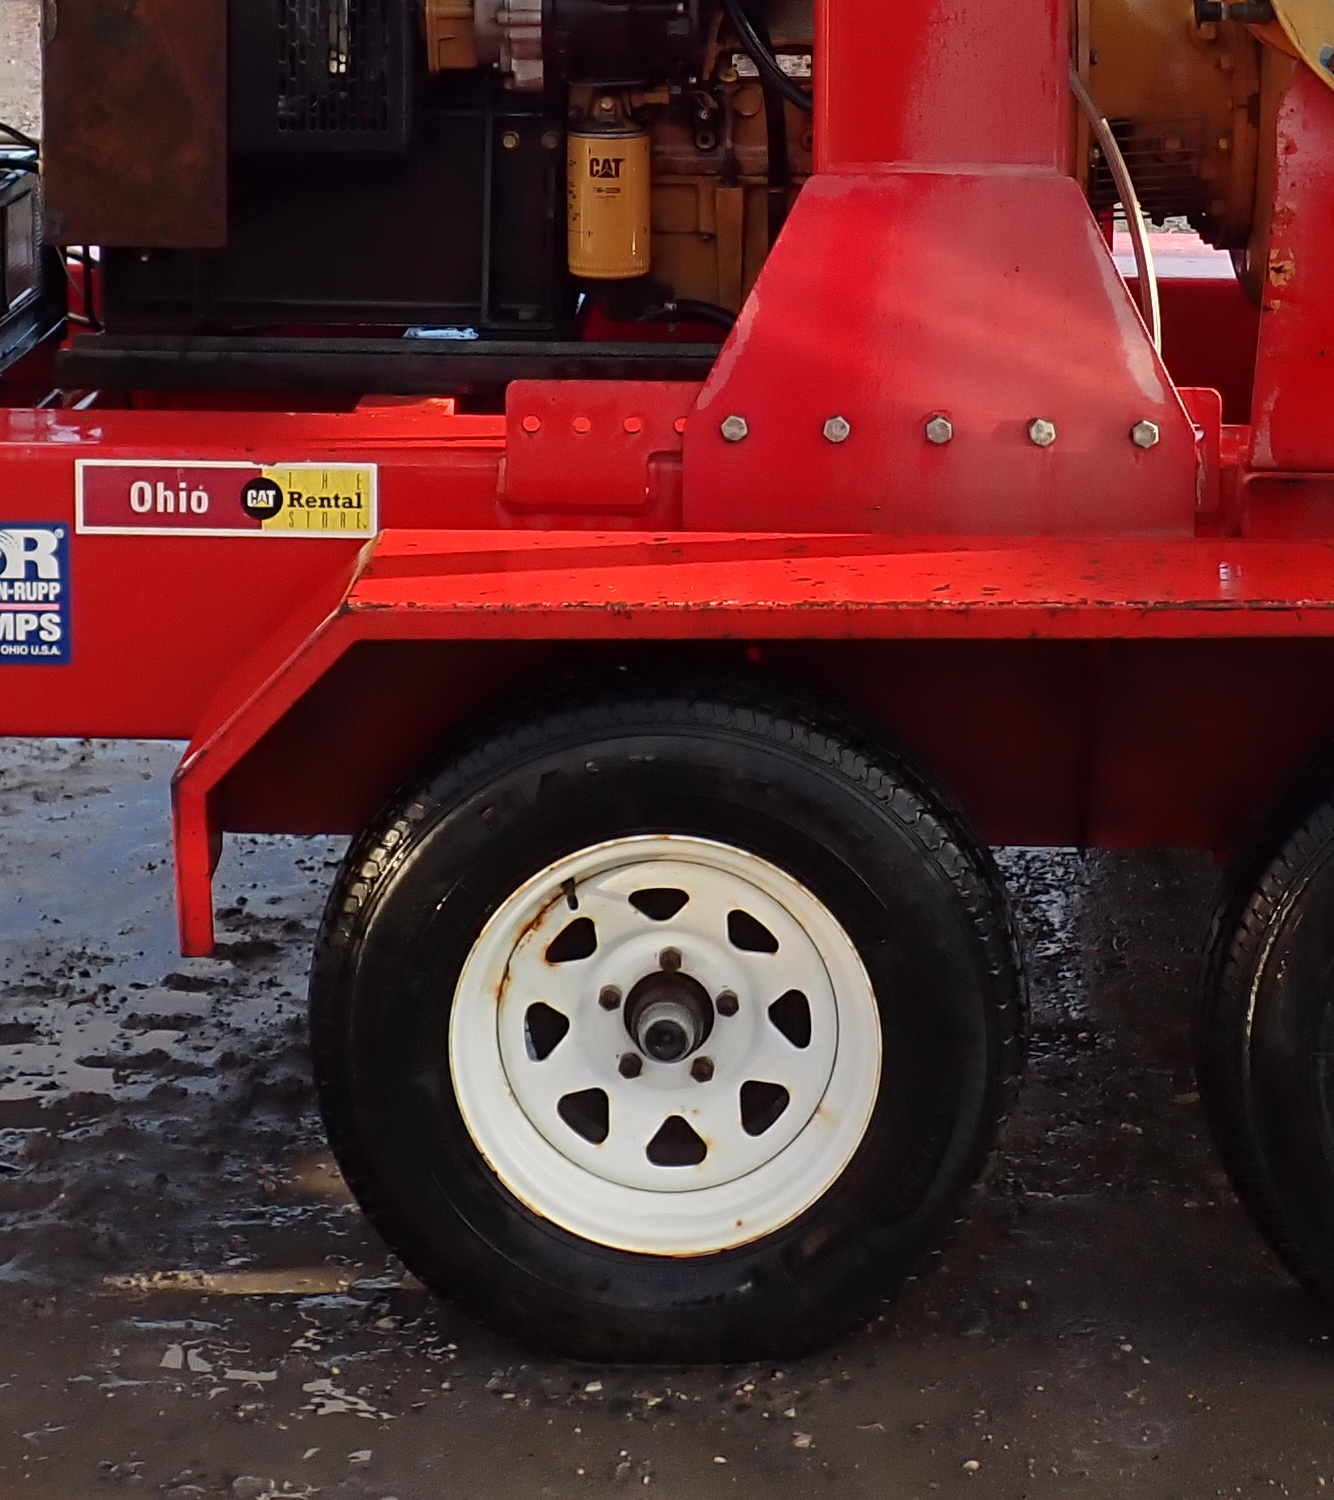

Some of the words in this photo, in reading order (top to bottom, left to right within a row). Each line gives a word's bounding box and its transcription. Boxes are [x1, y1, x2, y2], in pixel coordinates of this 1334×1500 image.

[589, 157, 626, 179] CAT
[129, 480, 210, 514] Ohio
[246, 489, 276, 508] CAT
[286, 491, 363, 509] Rental
[0, 645, 29, 655] OHIO
